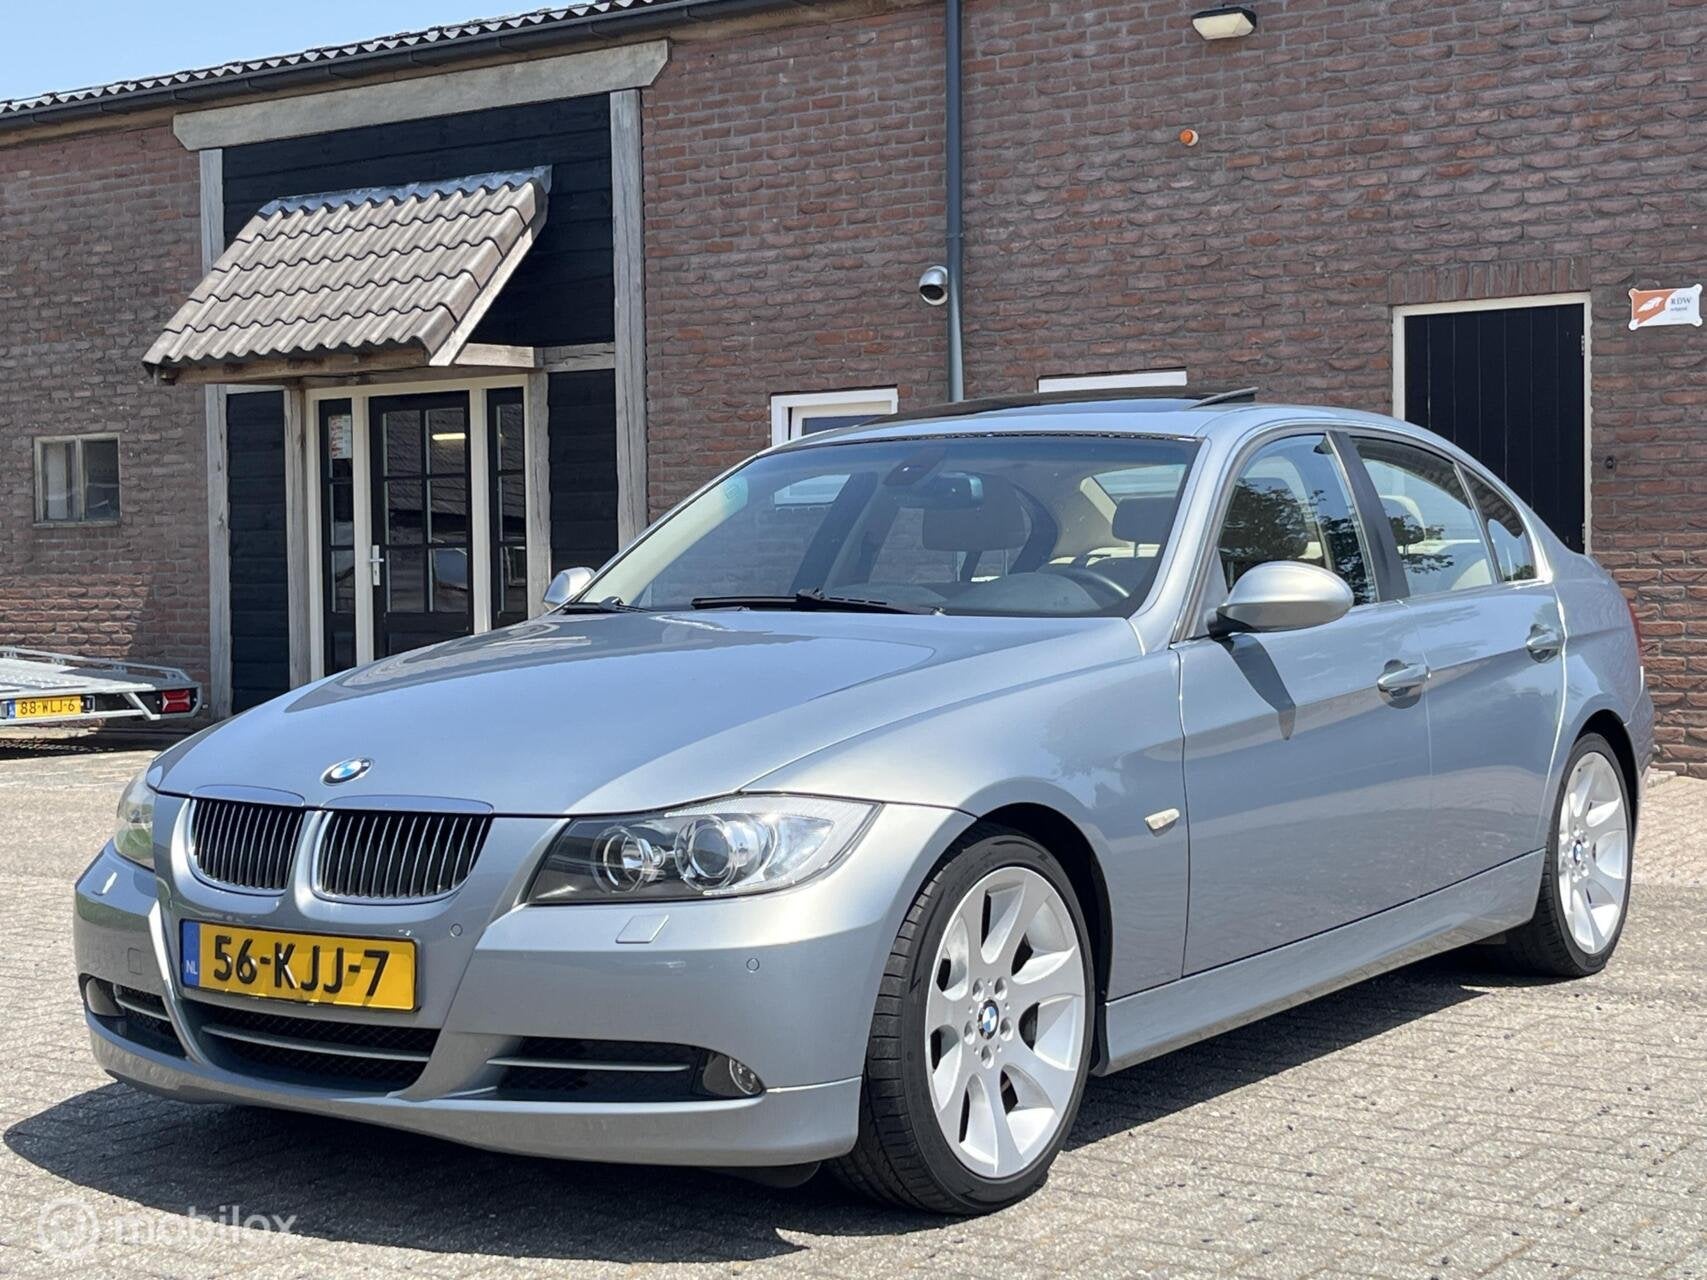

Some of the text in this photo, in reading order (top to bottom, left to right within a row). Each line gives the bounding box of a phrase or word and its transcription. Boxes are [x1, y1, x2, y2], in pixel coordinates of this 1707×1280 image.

[19, 701, 76, 715] 88-WLJ-6
[185, 934, 391, 997] NL 56-KJJ-7
